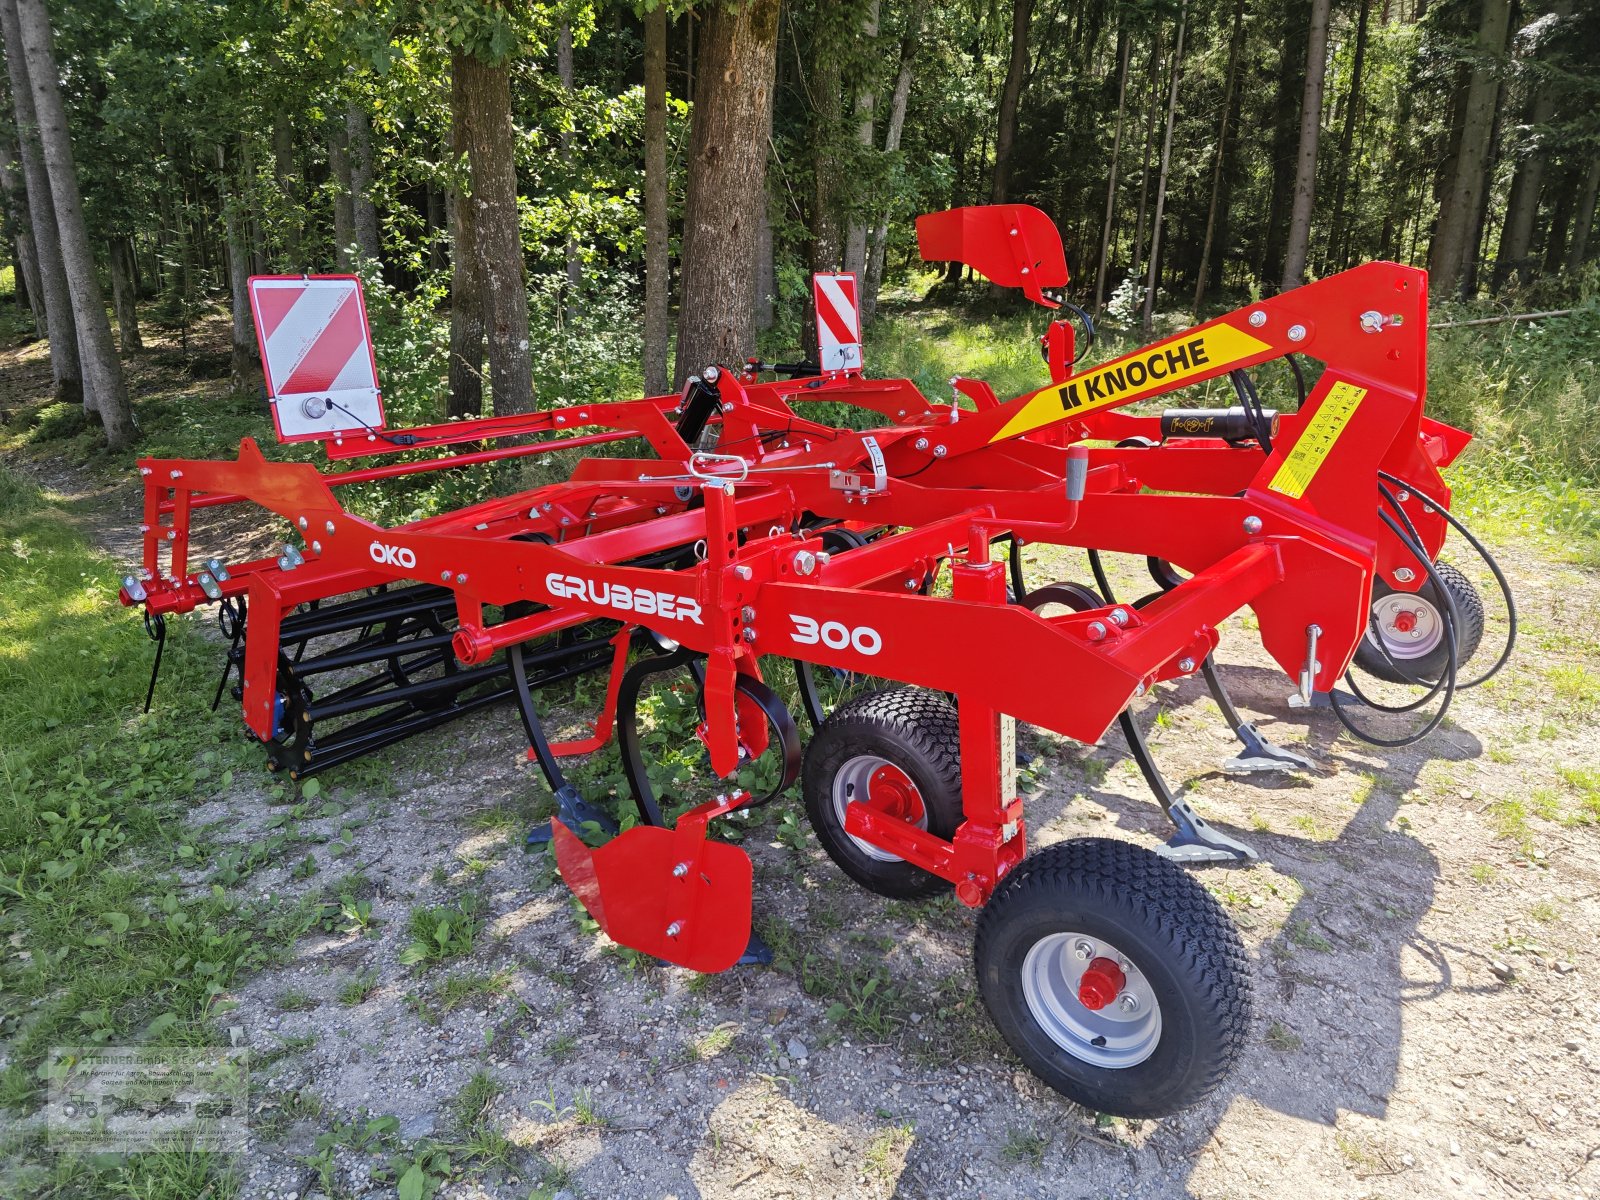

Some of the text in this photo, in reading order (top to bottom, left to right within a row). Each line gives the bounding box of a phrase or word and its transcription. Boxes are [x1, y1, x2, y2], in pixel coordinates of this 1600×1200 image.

[1084, 338, 1210, 403] KNOCHE
[369, 540, 883, 656] ÖKO GRUBBER 300
